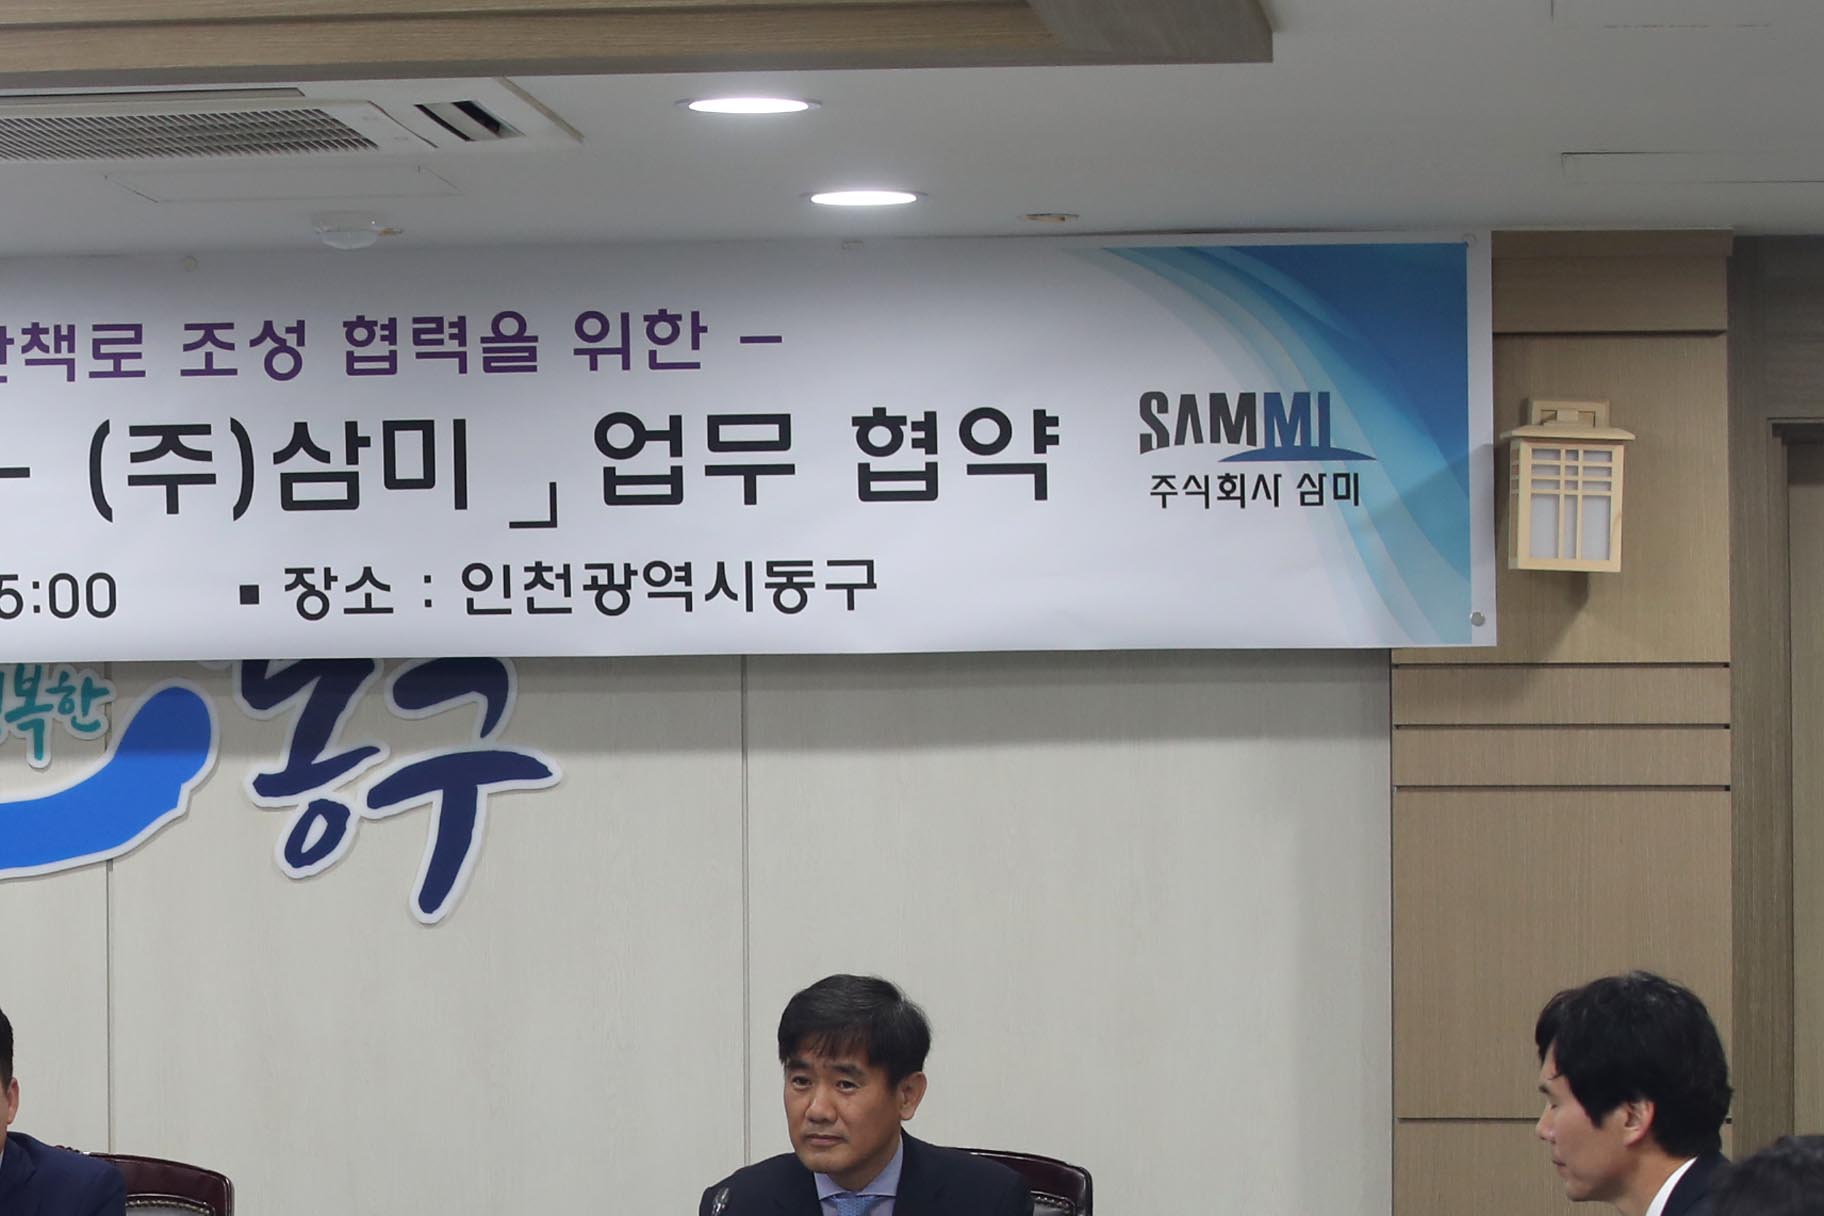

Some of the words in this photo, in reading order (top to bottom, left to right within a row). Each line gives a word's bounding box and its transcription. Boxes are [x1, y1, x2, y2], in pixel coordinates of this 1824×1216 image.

[179, 319, 307, 382] 조성
[342, 310, 540, 379] 협력을
[572, 308, 710, 373] 위한
[1139, 391, 1332, 455] SAMMI
[593, 411, 797, 508] 업무
[850, 406, 1062, 503] 협약
[1150, 473, 1282, 509] 주식회사
[1296, 473, 1360, 507] 삼미
[283, 565, 395, 622] 장소
[460, 558, 878, 617] 인천광역시동구
